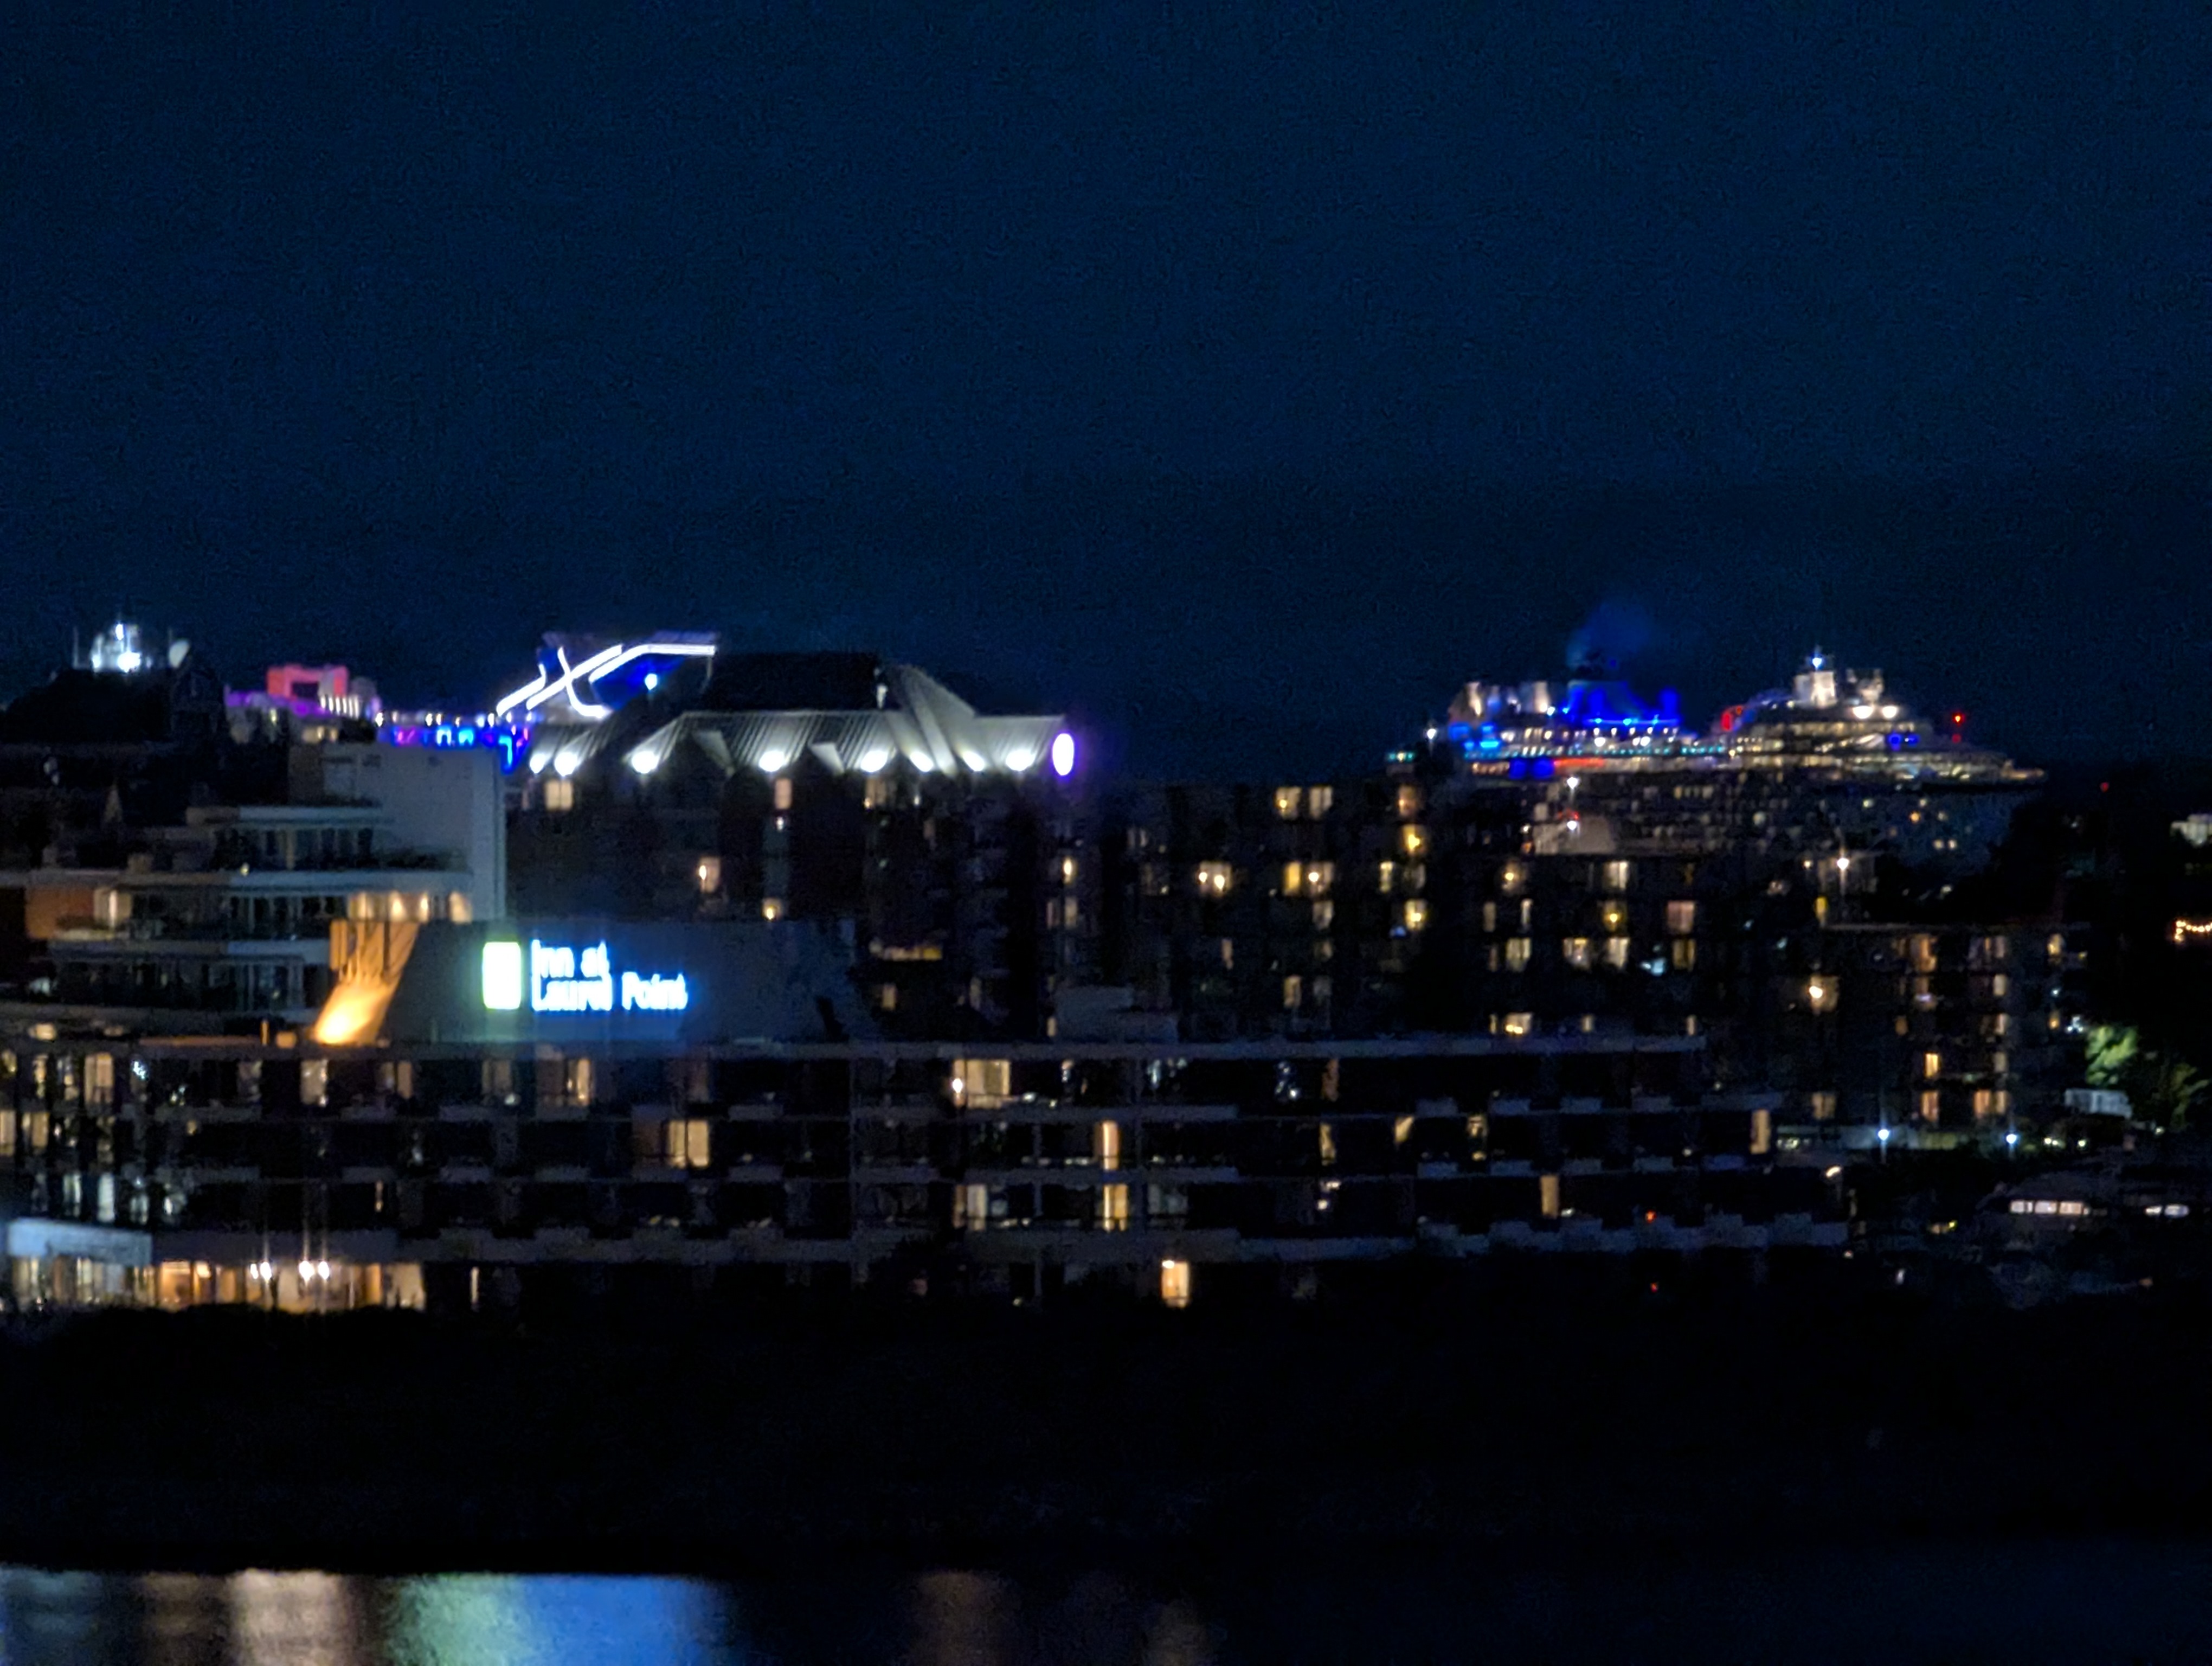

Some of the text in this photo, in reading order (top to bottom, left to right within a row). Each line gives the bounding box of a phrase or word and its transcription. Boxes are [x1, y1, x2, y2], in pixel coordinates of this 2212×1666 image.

[532, 939, 609, 977] Inn at
[622, 972, 688, 1010] Point
